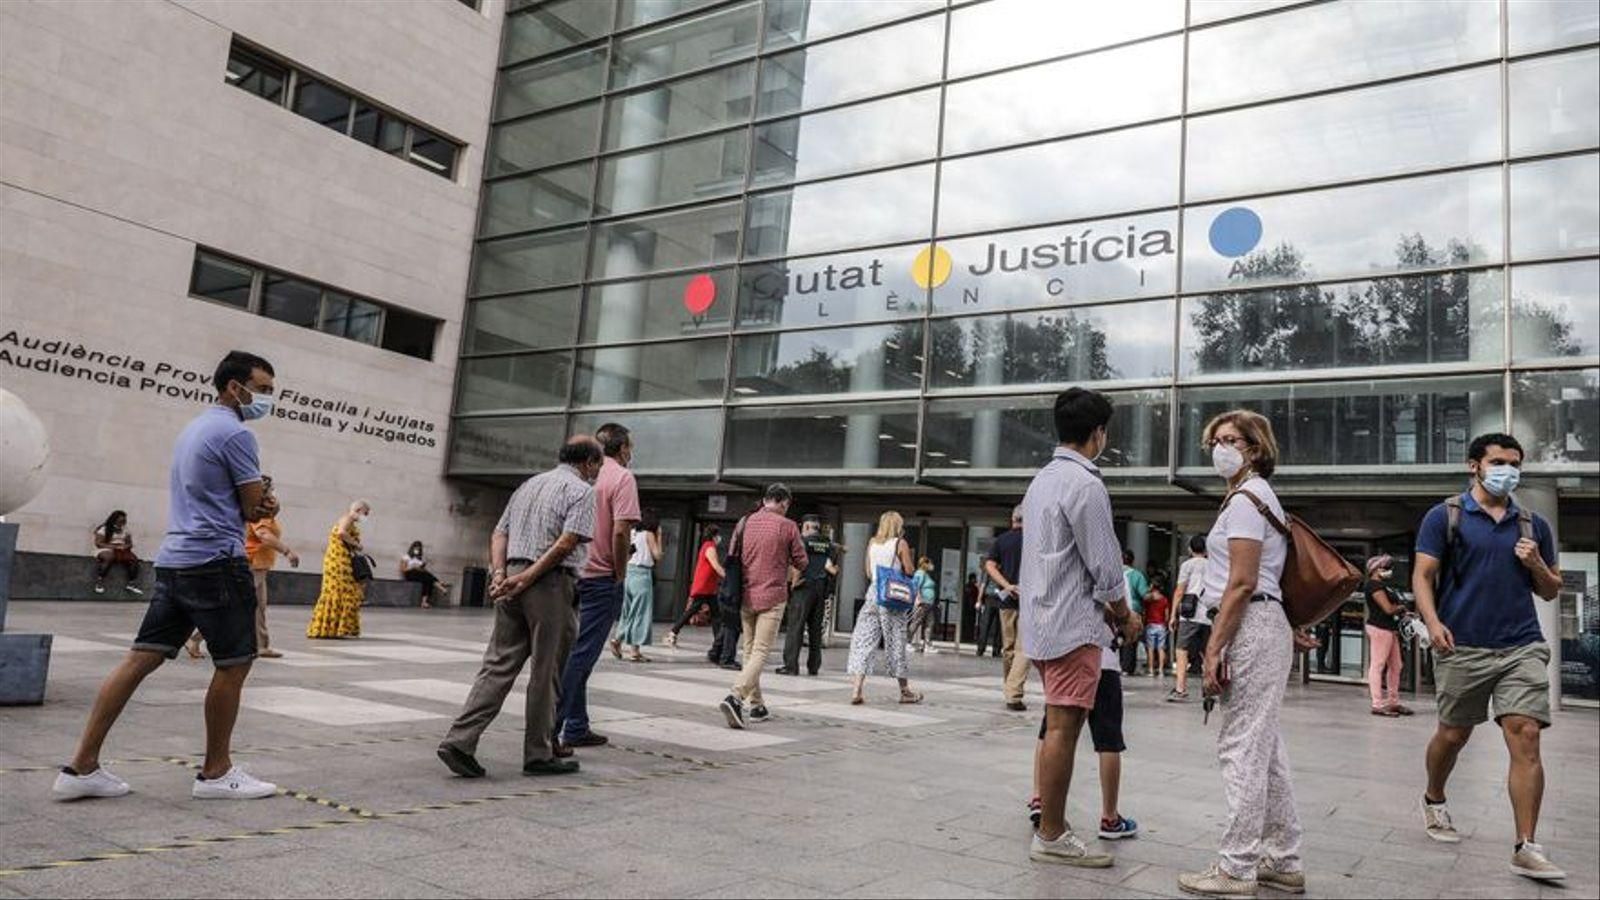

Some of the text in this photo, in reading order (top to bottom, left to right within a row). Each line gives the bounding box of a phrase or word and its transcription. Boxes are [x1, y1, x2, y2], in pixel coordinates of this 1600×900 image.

[752, 226, 1175, 300] Ciutat Justícia
[0, 331, 435, 433] Audiència Prov Fiscalia i Jutjats
[0, 349, 131, 388] Audiencia
[140, 377, 219, 404] Provin
[270, 404, 332, 428] iscalía
[338, 420, 349, 433] y
[353, 421, 436, 448] Juzgados
